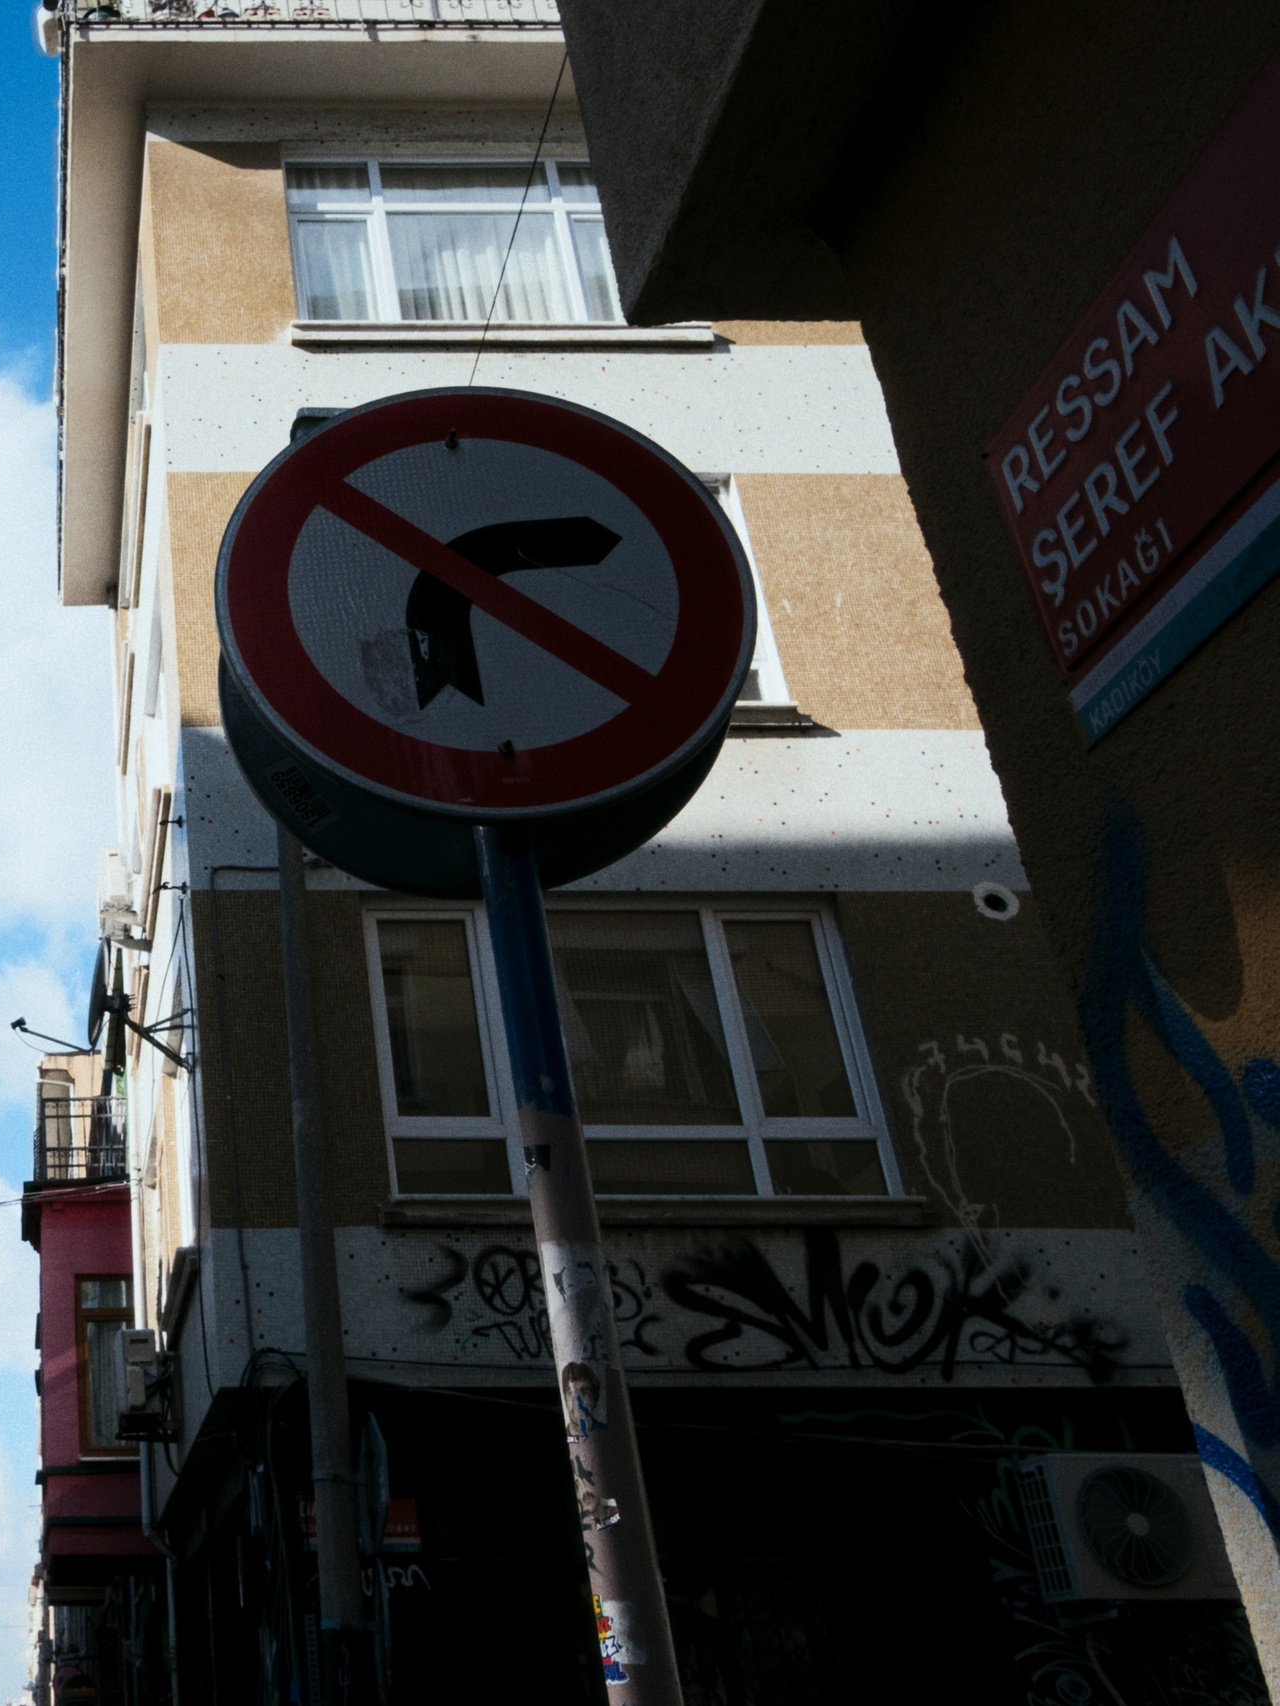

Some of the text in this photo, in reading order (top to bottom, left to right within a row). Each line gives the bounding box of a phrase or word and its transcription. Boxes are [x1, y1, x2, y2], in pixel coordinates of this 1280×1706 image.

[1001, 234, 1200, 515] RESSAM
[1032, 239, 1280, 608] ŞEREF AK
[1057, 517, 1176, 659] SOKAĞI
[1088, 647, 1166, 735] KADIKÖY
[271, 769, 320, 830] 1506859
